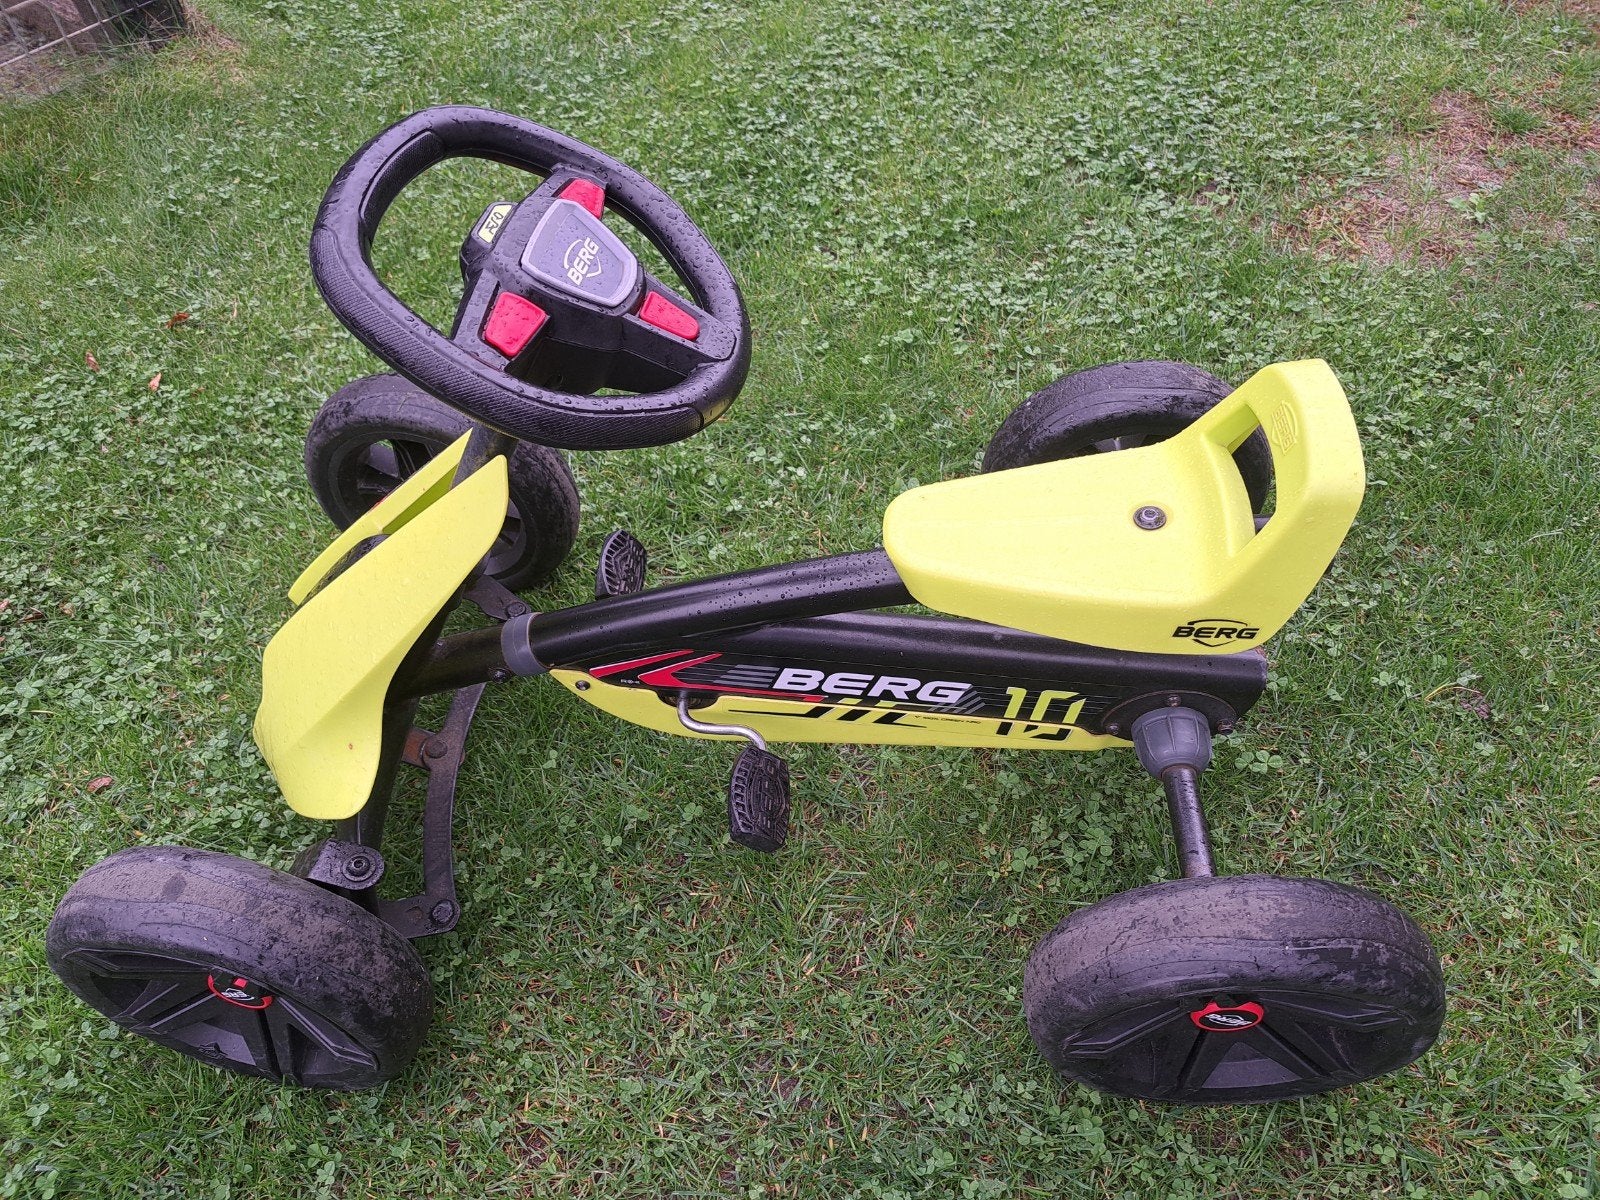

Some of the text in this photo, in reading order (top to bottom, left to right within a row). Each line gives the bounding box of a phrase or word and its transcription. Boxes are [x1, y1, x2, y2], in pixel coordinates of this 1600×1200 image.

[566, 237, 600, 285] BERG
[1172, 626, 1260, 640] BERG
[772, 667, 974, 704] BERG
[996, 686, 1087, 741] 10
